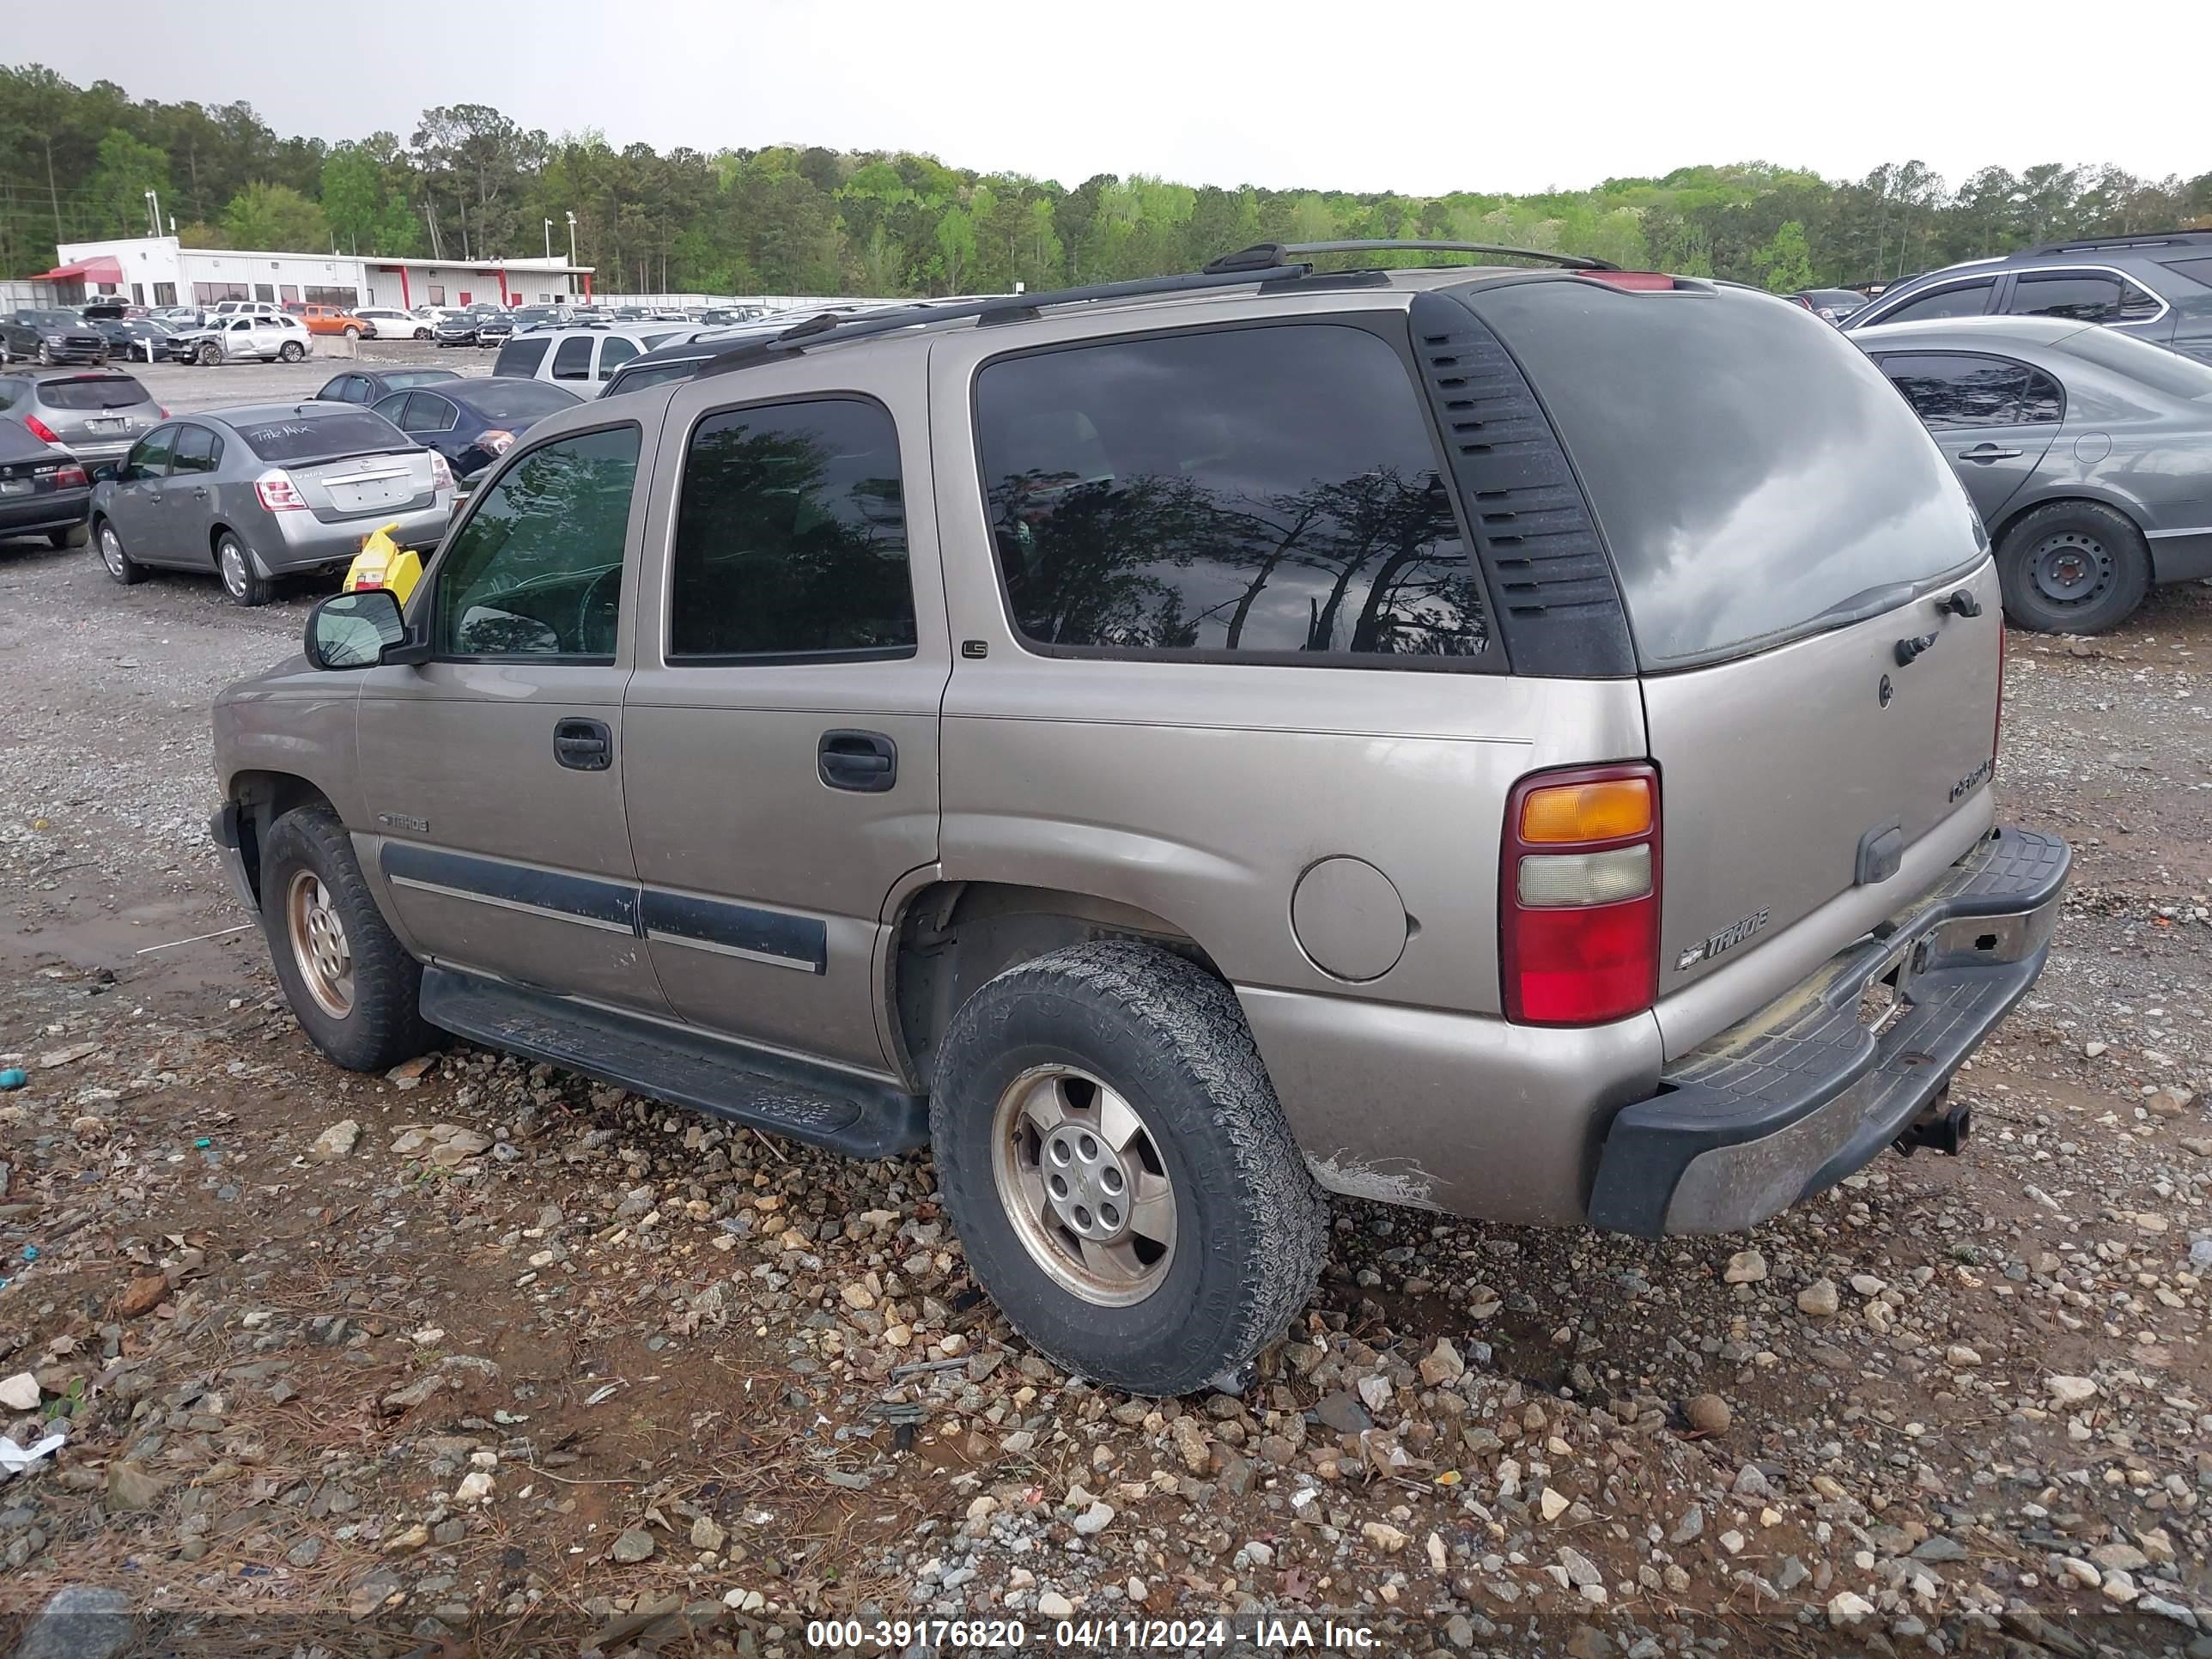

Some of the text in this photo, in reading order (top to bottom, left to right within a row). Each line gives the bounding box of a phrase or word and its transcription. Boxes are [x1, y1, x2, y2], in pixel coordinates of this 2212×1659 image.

[963, 643, 988, 655] LS
[392, 815, 428, 832] TAHOE
[1705, 908, 1770, 958] TAHOE
